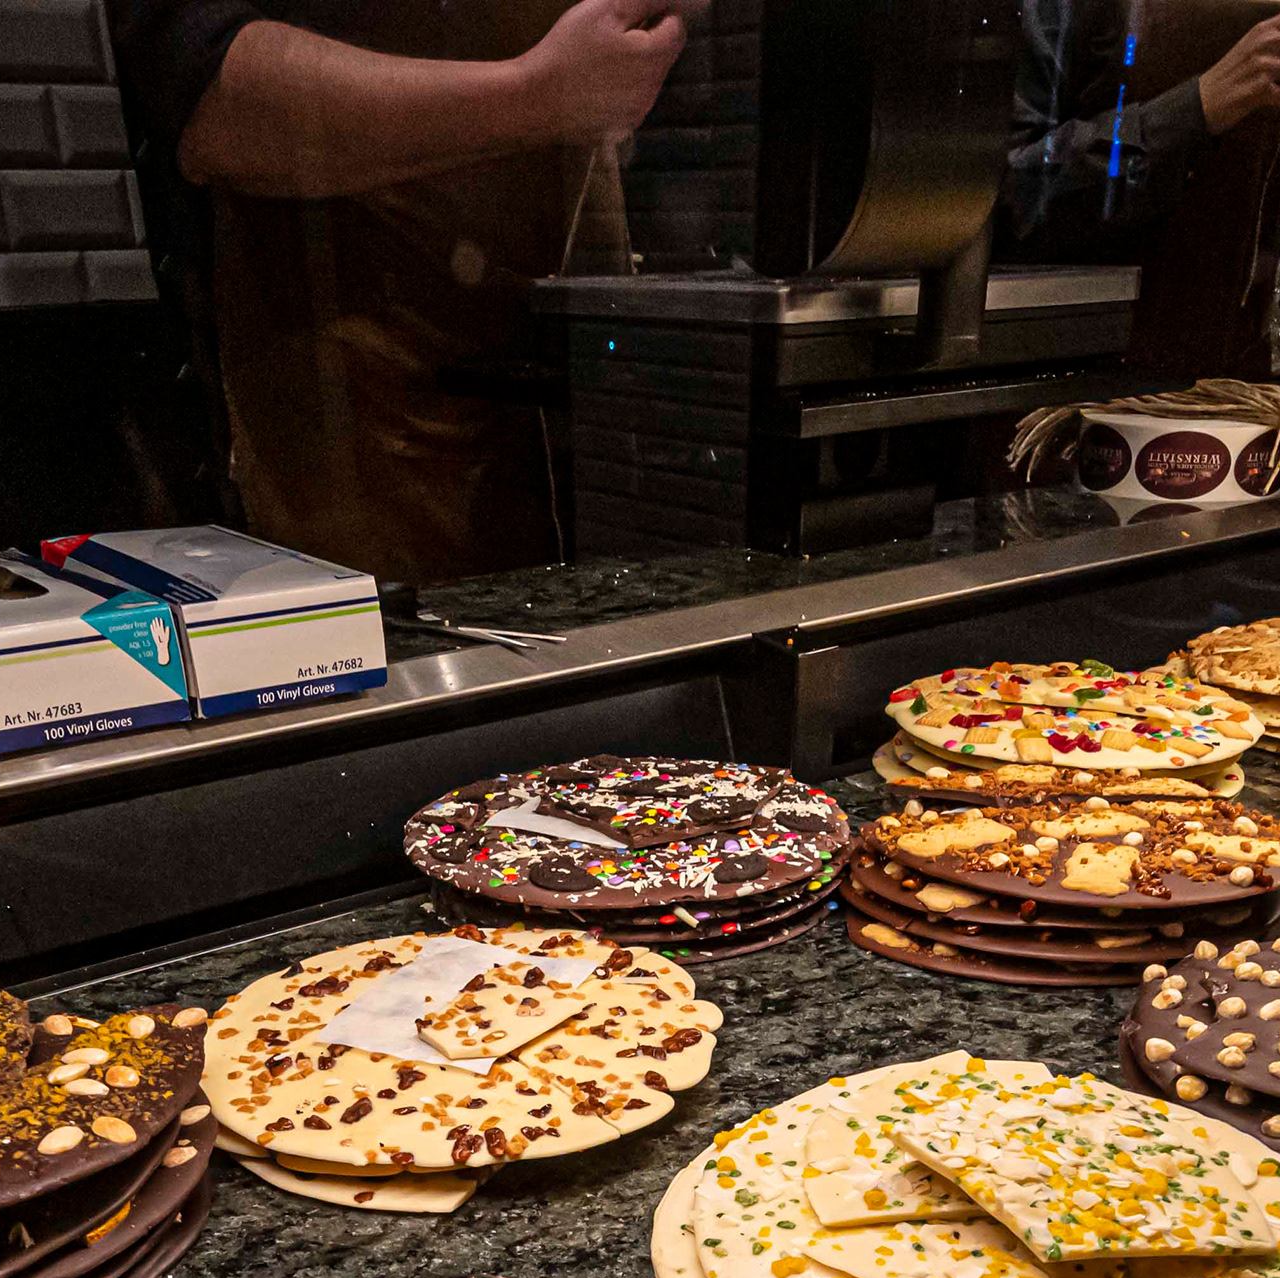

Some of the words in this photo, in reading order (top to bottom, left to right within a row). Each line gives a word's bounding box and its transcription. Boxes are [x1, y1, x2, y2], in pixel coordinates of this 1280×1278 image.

[1147, 452, 1221, 464] WERKSTATT
[108, 622, 134, 633] powder
[134, 620, 148, 630] free
[297, 667, 315, 678] Art.
[317, 664, 331, 675] Nr.
[331, 657, 364, 672] 47682
[256, 691, 275, 705] 100
[276, 686, 301, 700] Vinyl
[302, 683, 335, 697] Gloves
[4, 714, 26, 727] Art.
[26, 710, 45, 722] Nr.
[45, 702, 83, 719] 47683
[43, 726, 65, 741] 100
[66, 720, 94, 736] Vinyl
[95, 716, 133, 732] Gloves
